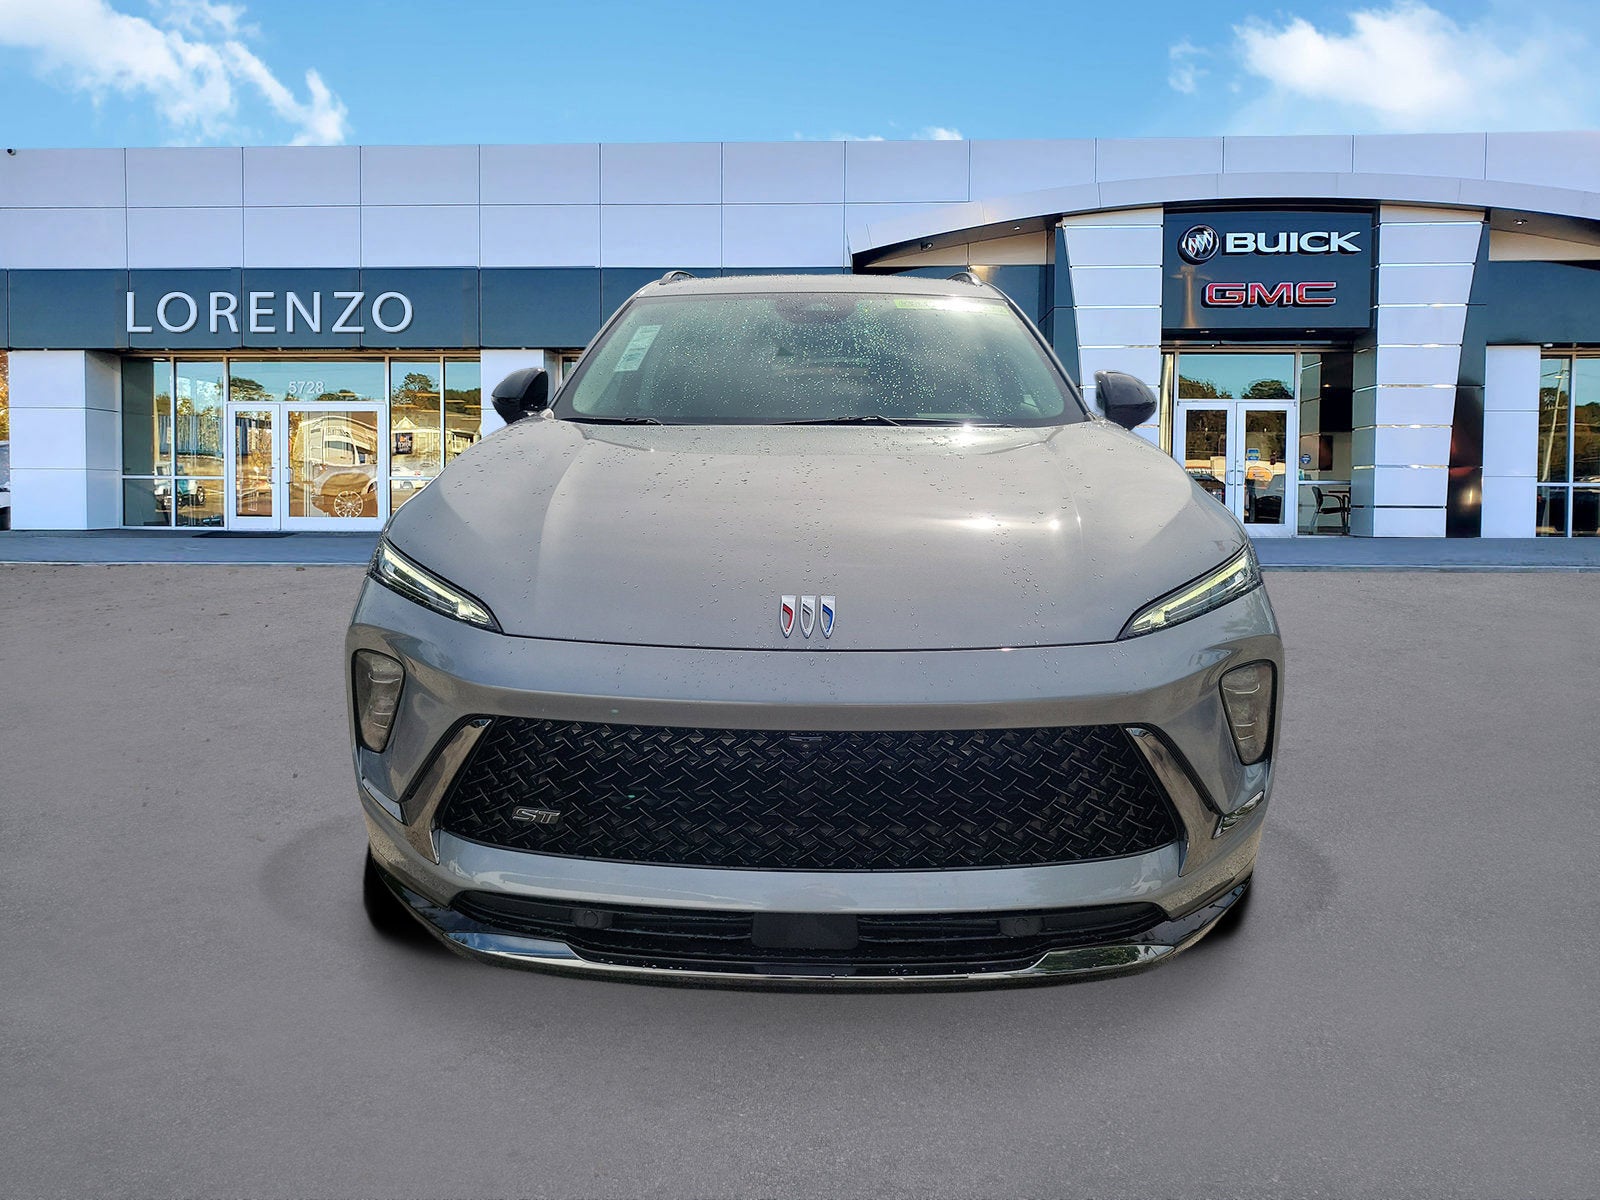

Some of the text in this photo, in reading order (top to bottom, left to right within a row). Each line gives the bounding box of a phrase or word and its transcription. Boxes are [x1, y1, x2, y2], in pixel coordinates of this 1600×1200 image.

[1225, 231, 1362, 253] BUICK
[1205, 281, 1337, 306] GMC
[126, 291, 414, 334] LORENZO
[288, 380, 325, 394] 5728
[511, 807, 561, 824] ST
